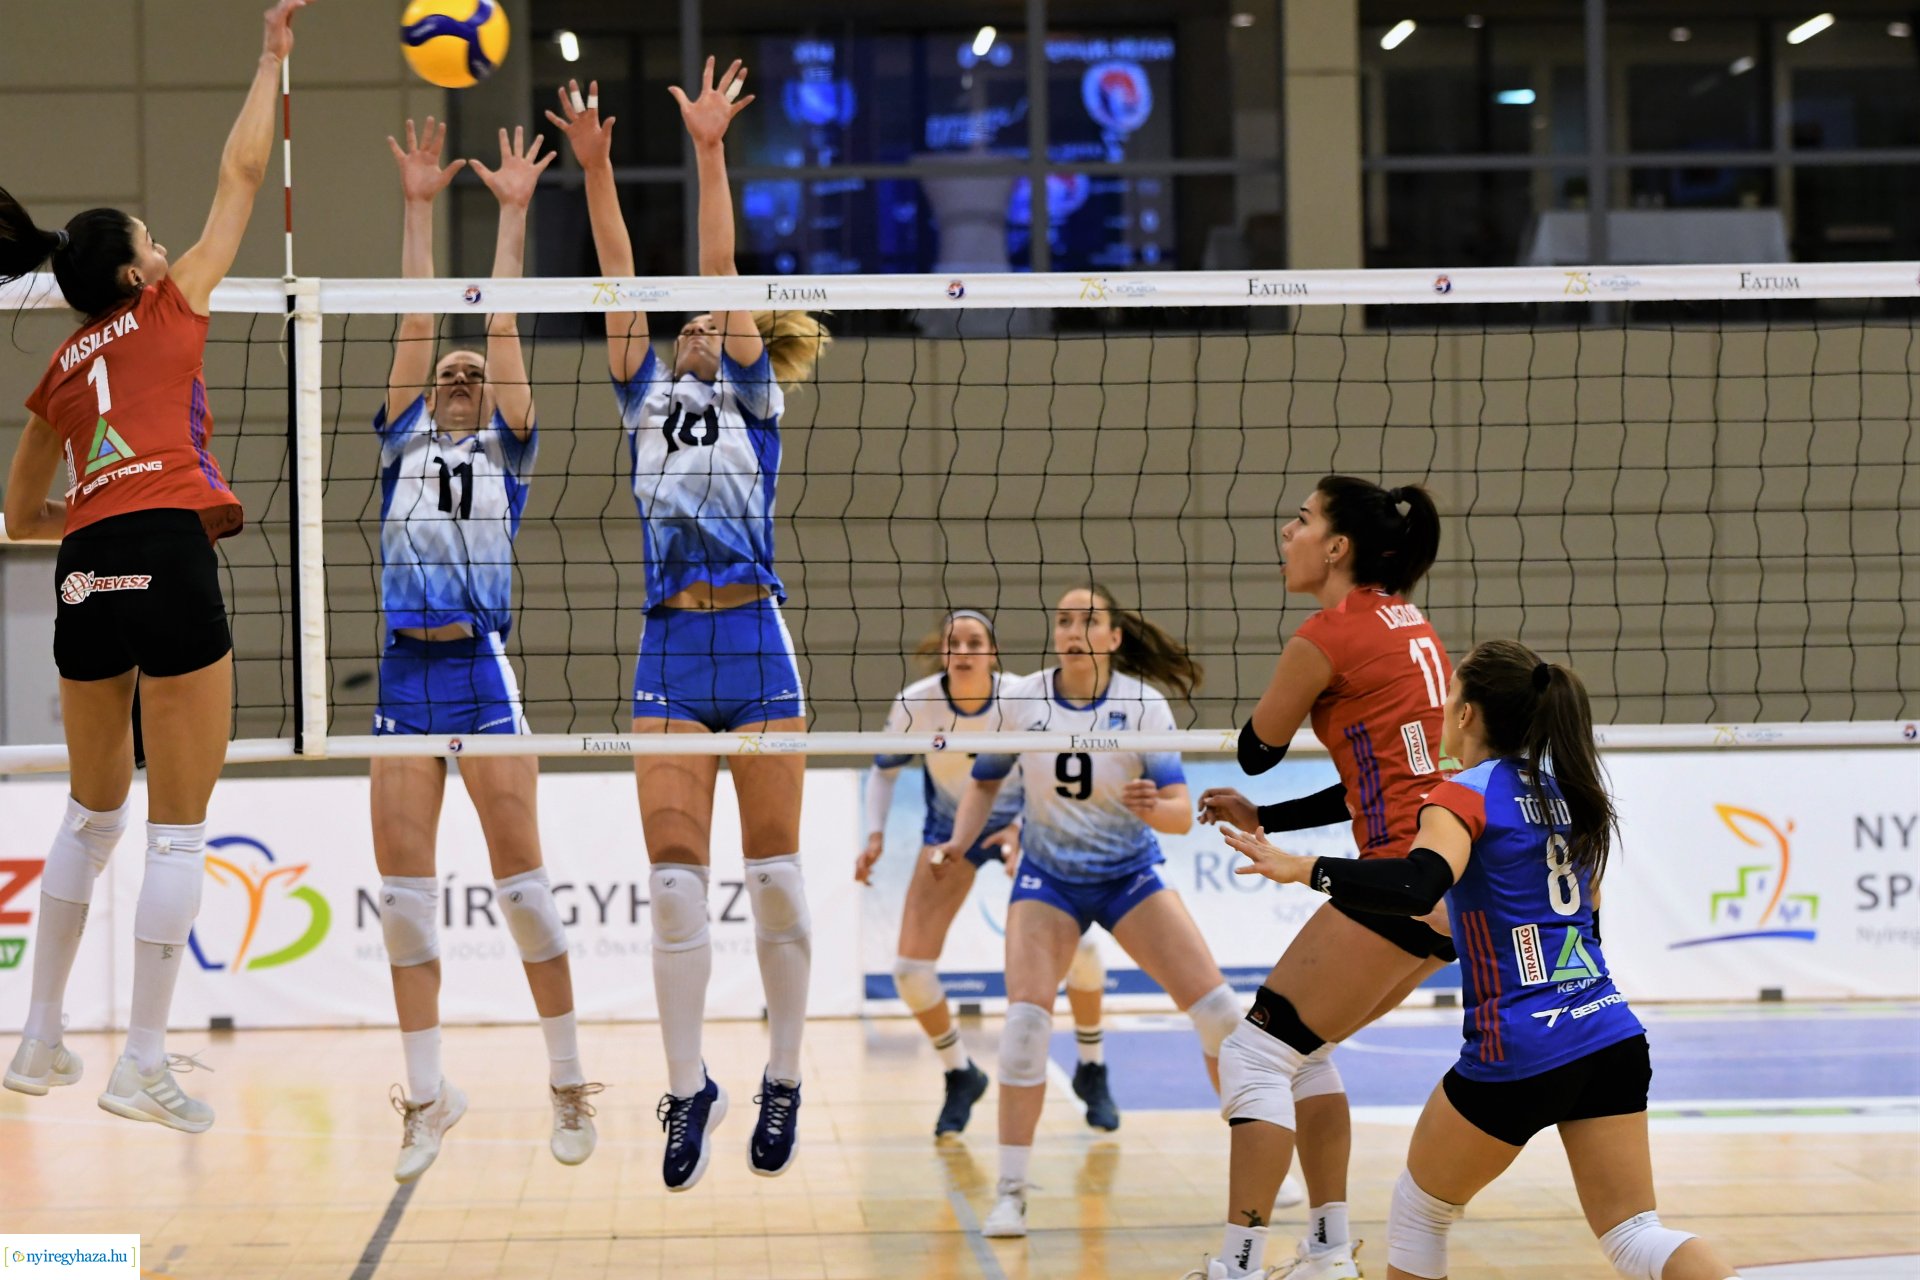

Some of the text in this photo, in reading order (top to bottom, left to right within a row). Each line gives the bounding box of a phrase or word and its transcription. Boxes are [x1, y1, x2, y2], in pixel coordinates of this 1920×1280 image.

[60, 312, 139, 372] VASILEVA
[87, 355, 112, 415] 1
[662, 401, 719, 454] 10
[83, 461, 162, 495] BESTRONG
[433, 456, 473, 520] 11
[1409, 637, 1447, 708] 17
[1070, 735, 1119, 749] FATUM
[1409, 725, 1427, 772] STRABAG
[1055, 753, 1092, 800] 9
[1546, 834, 1581, 916] 8
[1856, 873, 1920, 911] SP
[1520, 927, 1539, 982] STRABAG
